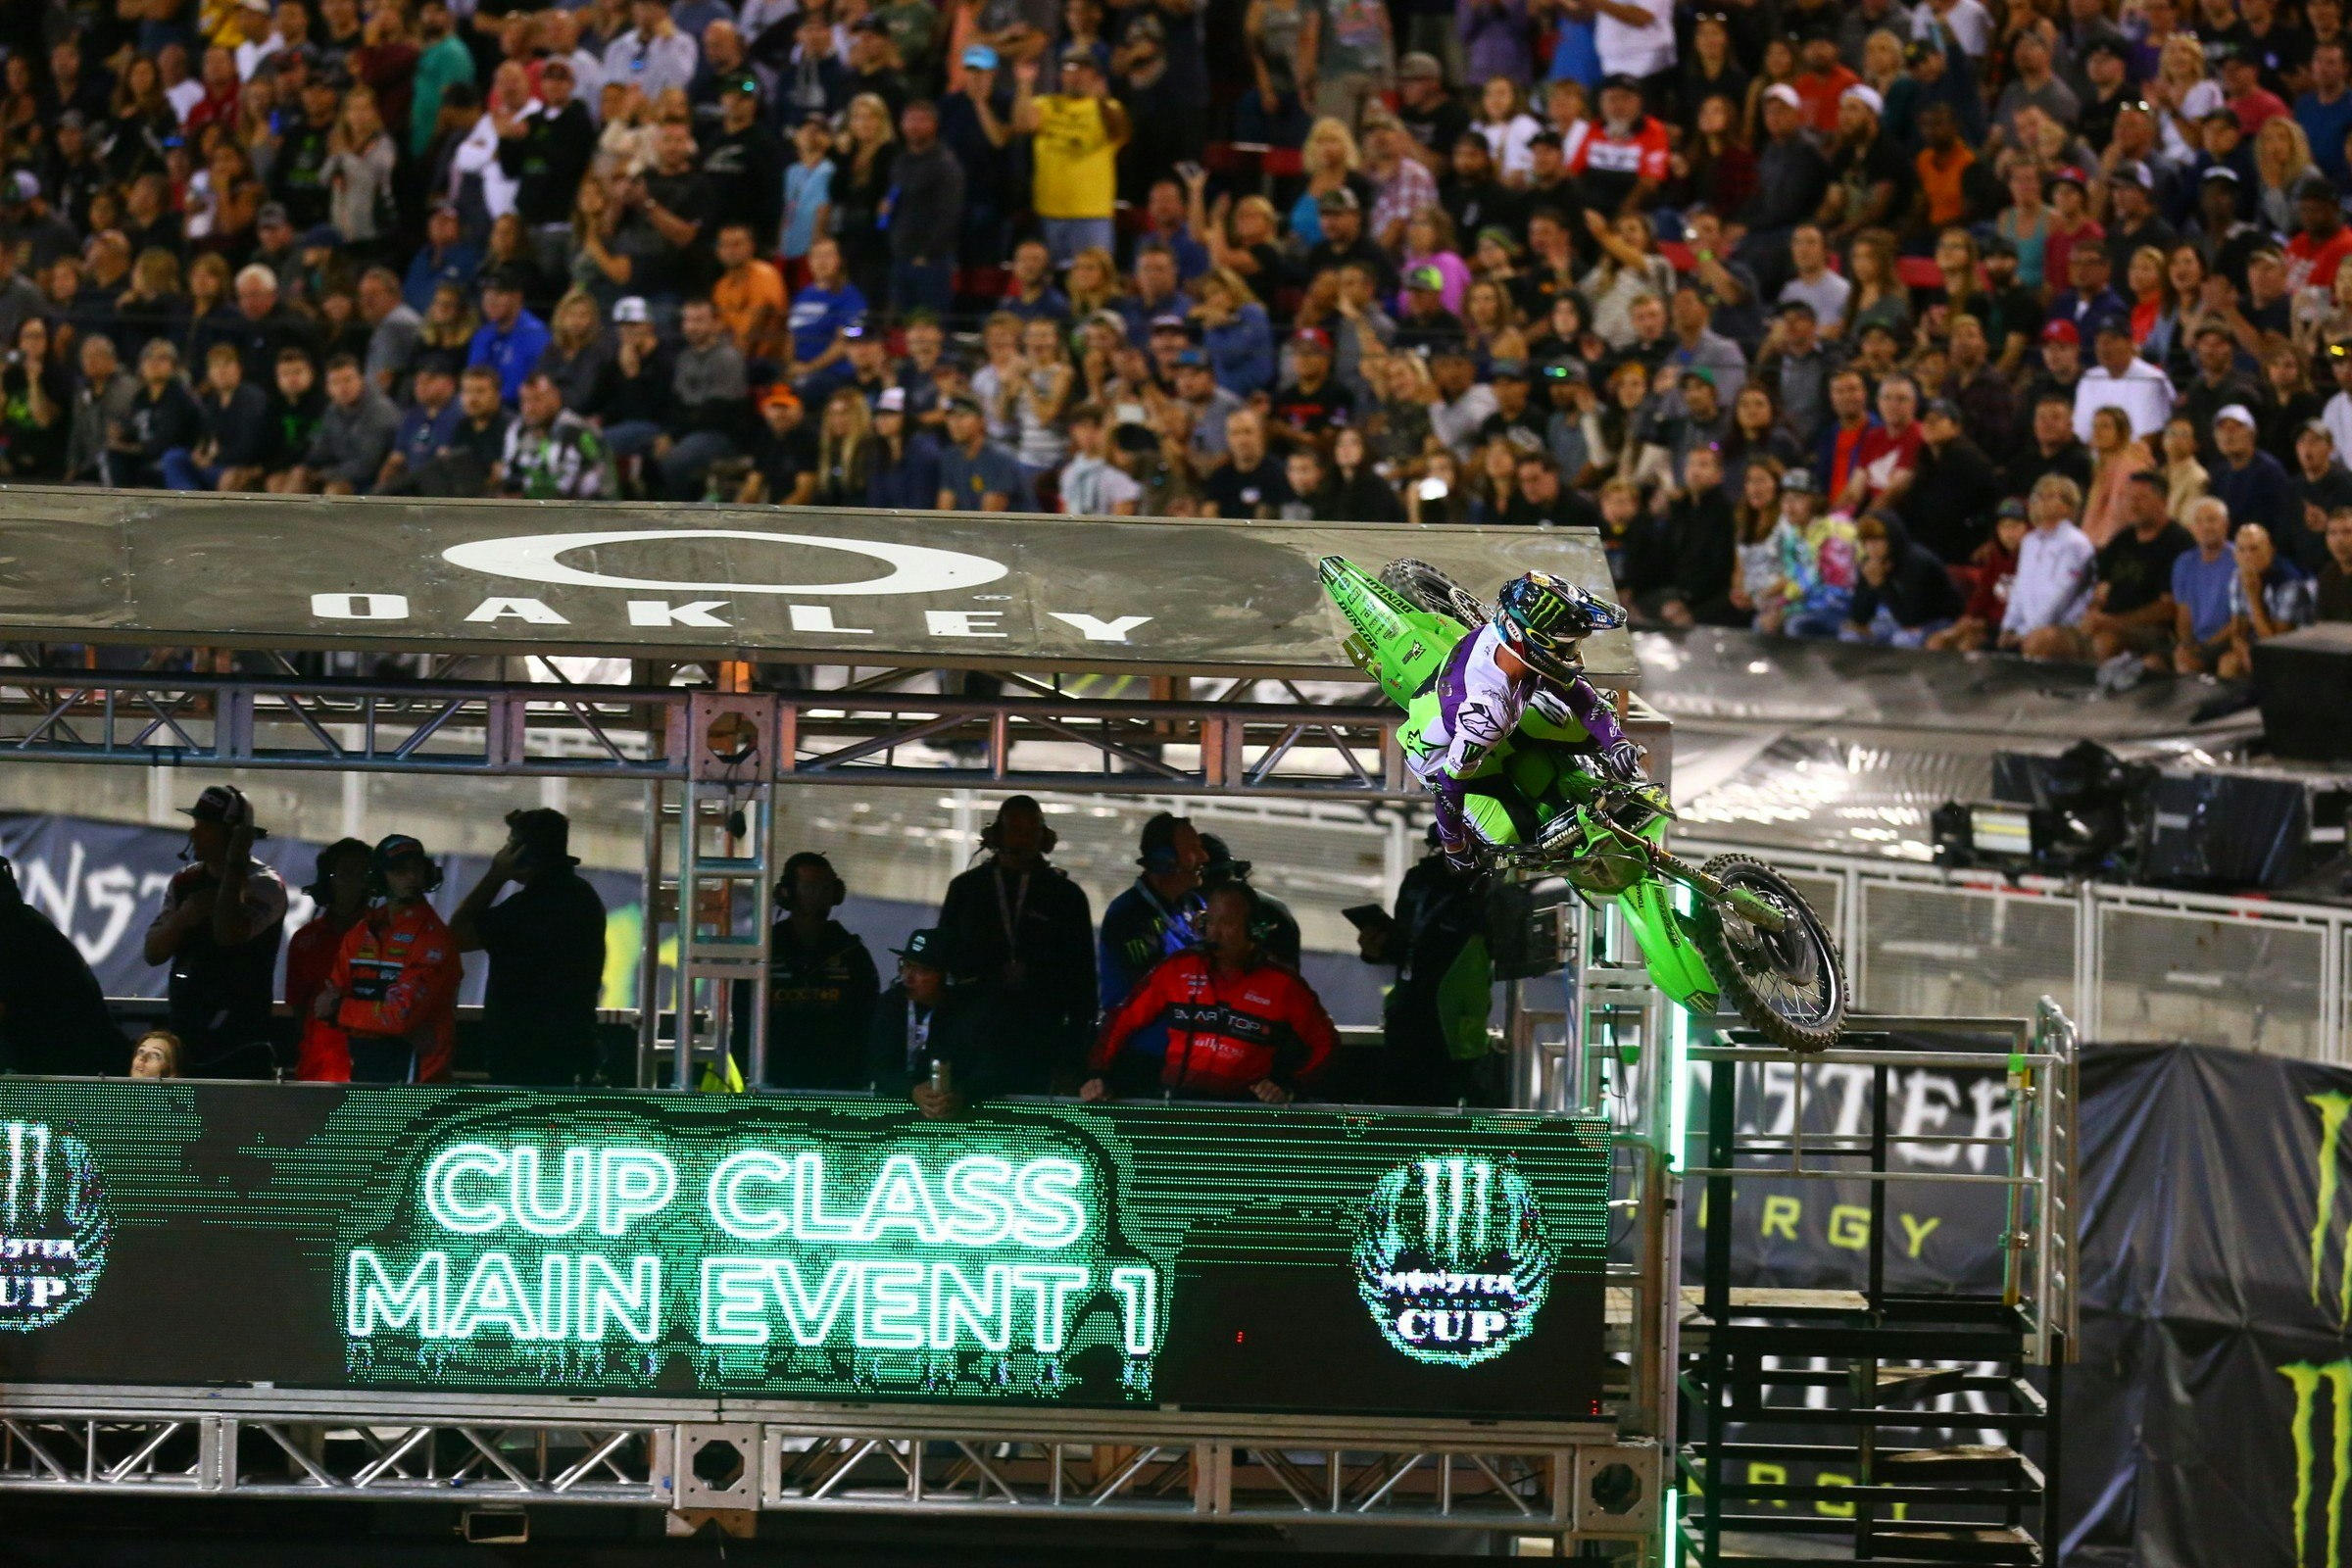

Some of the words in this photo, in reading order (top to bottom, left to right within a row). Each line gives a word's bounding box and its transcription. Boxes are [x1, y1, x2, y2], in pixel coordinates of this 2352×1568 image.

[311, 592, 1154, 642] OAKLEY
[1337, 600, 1380, 651] DUNLOP
[1507, 621, 1520, 640] BELL
[1542, 823, 1581, 851] RENTHAL
[423, 1144, 678, 1238] CUP
[707, 1149, 1088, 1249] CLASS
[346, 1248, 662, 1342] MAIN
[698, 1253, 1091, 1354] EVENT
[1109, 1266, 1157, 1355] 1
[1396, 1308, 1506, 1343] CUP
